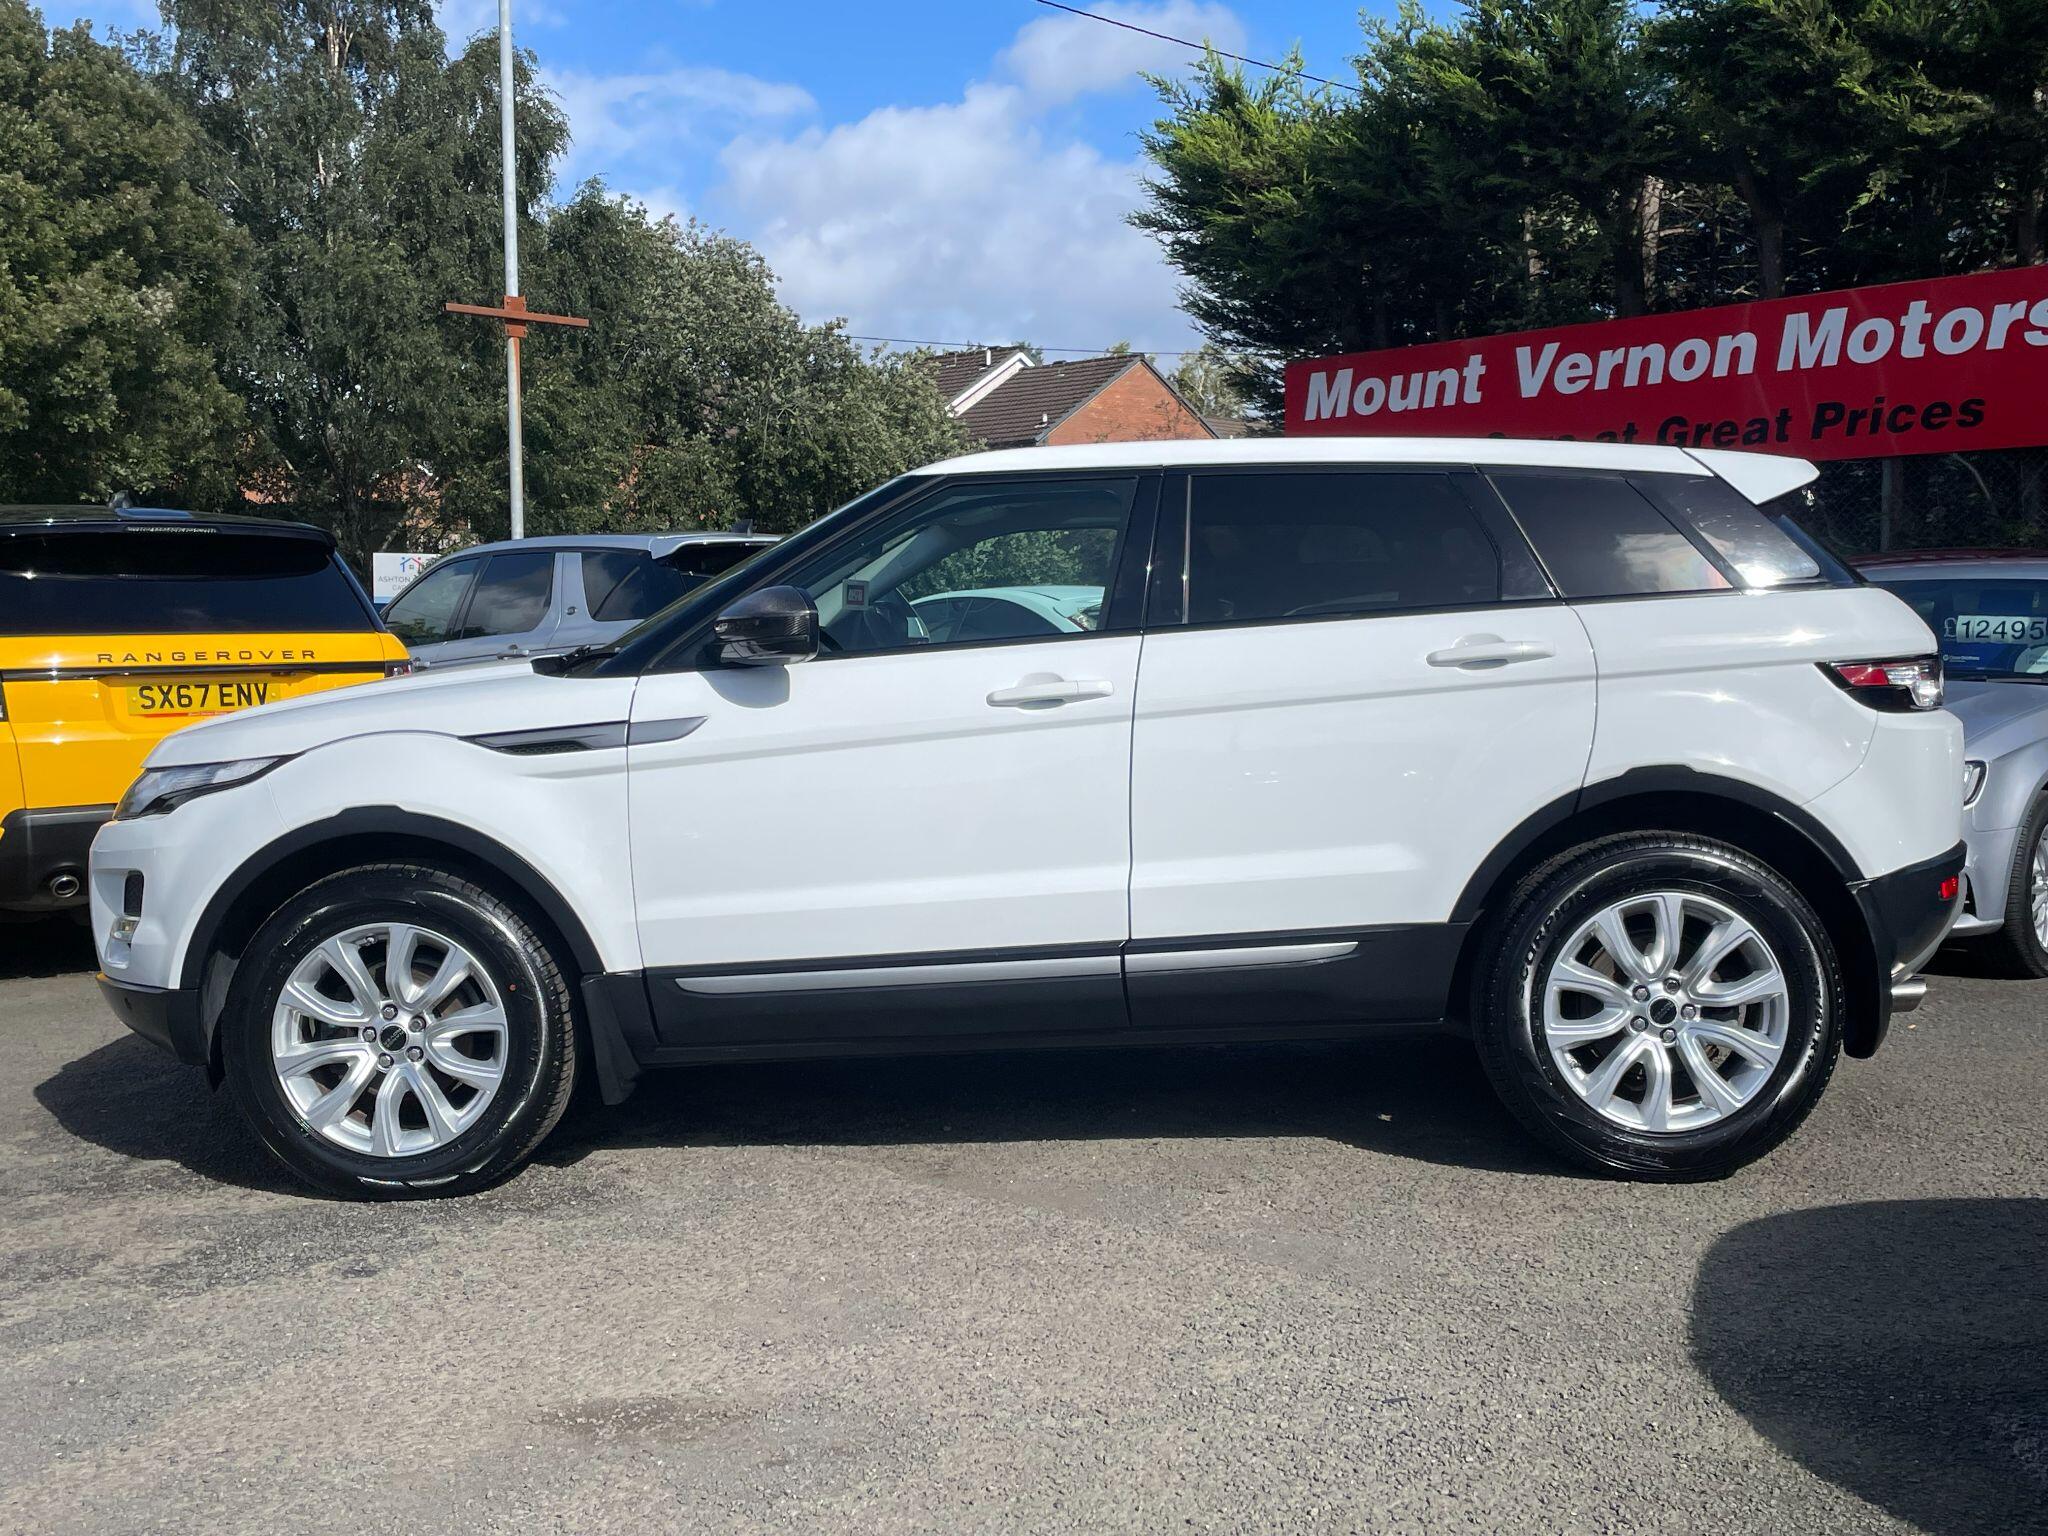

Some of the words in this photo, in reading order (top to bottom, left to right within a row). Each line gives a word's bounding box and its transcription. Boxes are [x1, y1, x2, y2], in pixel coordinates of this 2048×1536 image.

[1304, 354, 1486, 421] Mount
[1515, 331, 1757, 398] Vernon
[1657, 408, 1792, 448] Great
[1811, 396, 1986, 440] Prices
[138, 682, 210, 709] SX67
[218, 682, 268, 707] ENV
